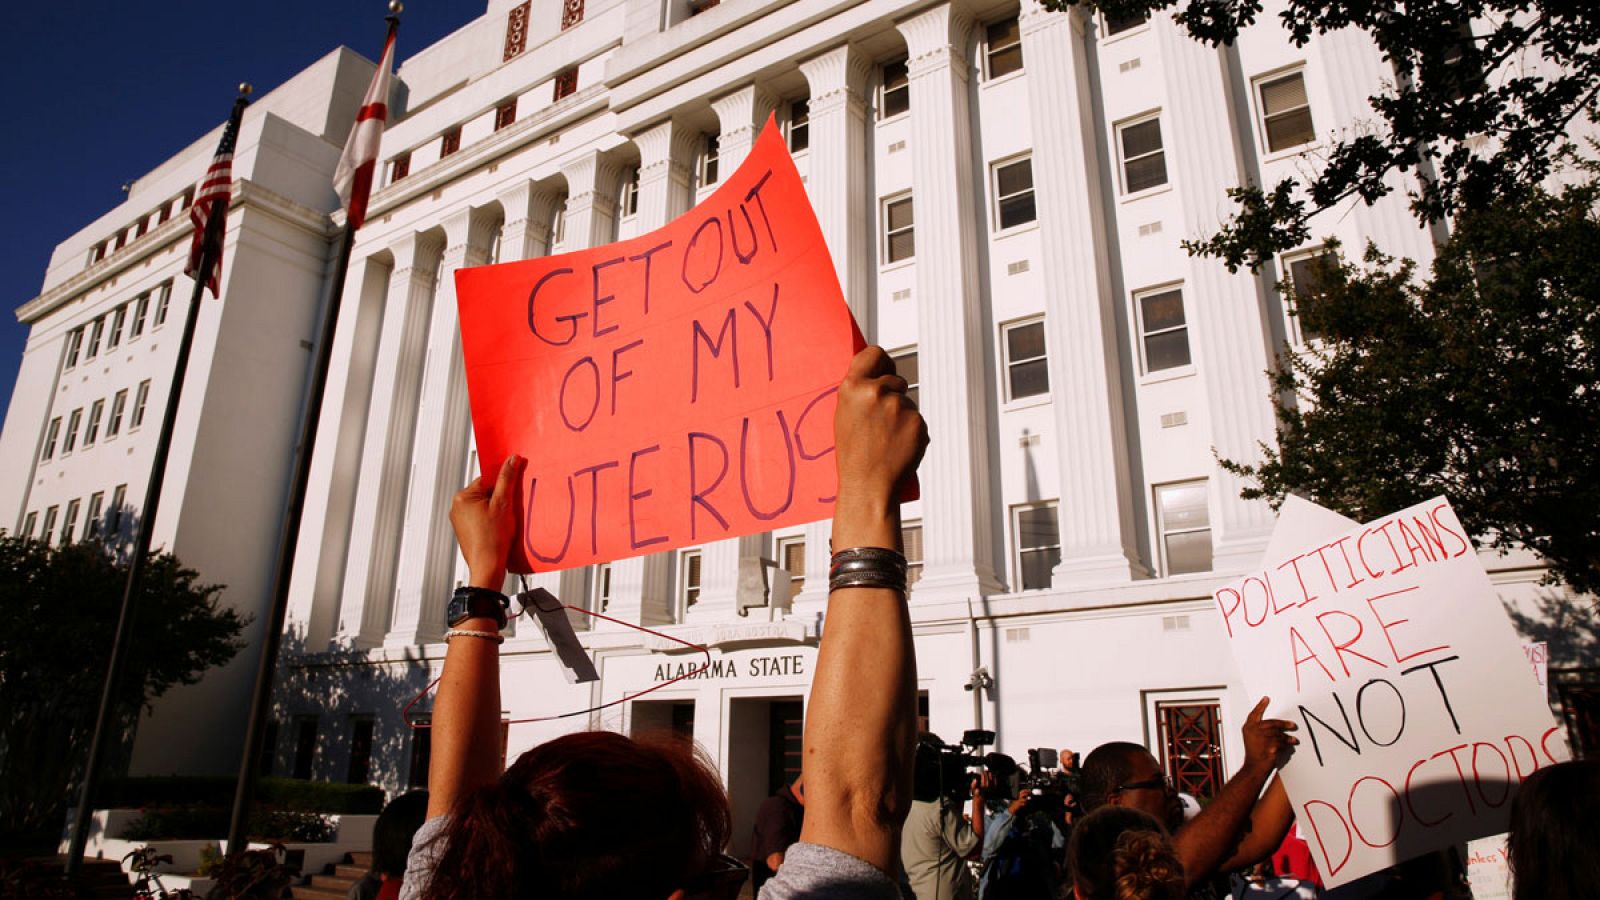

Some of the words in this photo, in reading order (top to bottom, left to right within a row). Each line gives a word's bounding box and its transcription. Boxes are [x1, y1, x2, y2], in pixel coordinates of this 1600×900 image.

[528, 240, 673, 347] GET
[681, 168, 778, 294] OUT
[559, 339, 644, 432] OF
[690, 282, 780, 404] MY
[1215, 504, 1468, 638] POLITICIANS
[654, 660, 737, 681] ALABAMA
[749, 655, 804, 677] STATE
[1290, 586, 1451, 692] ARE
[1298, 655, 1460, 767] NOT
